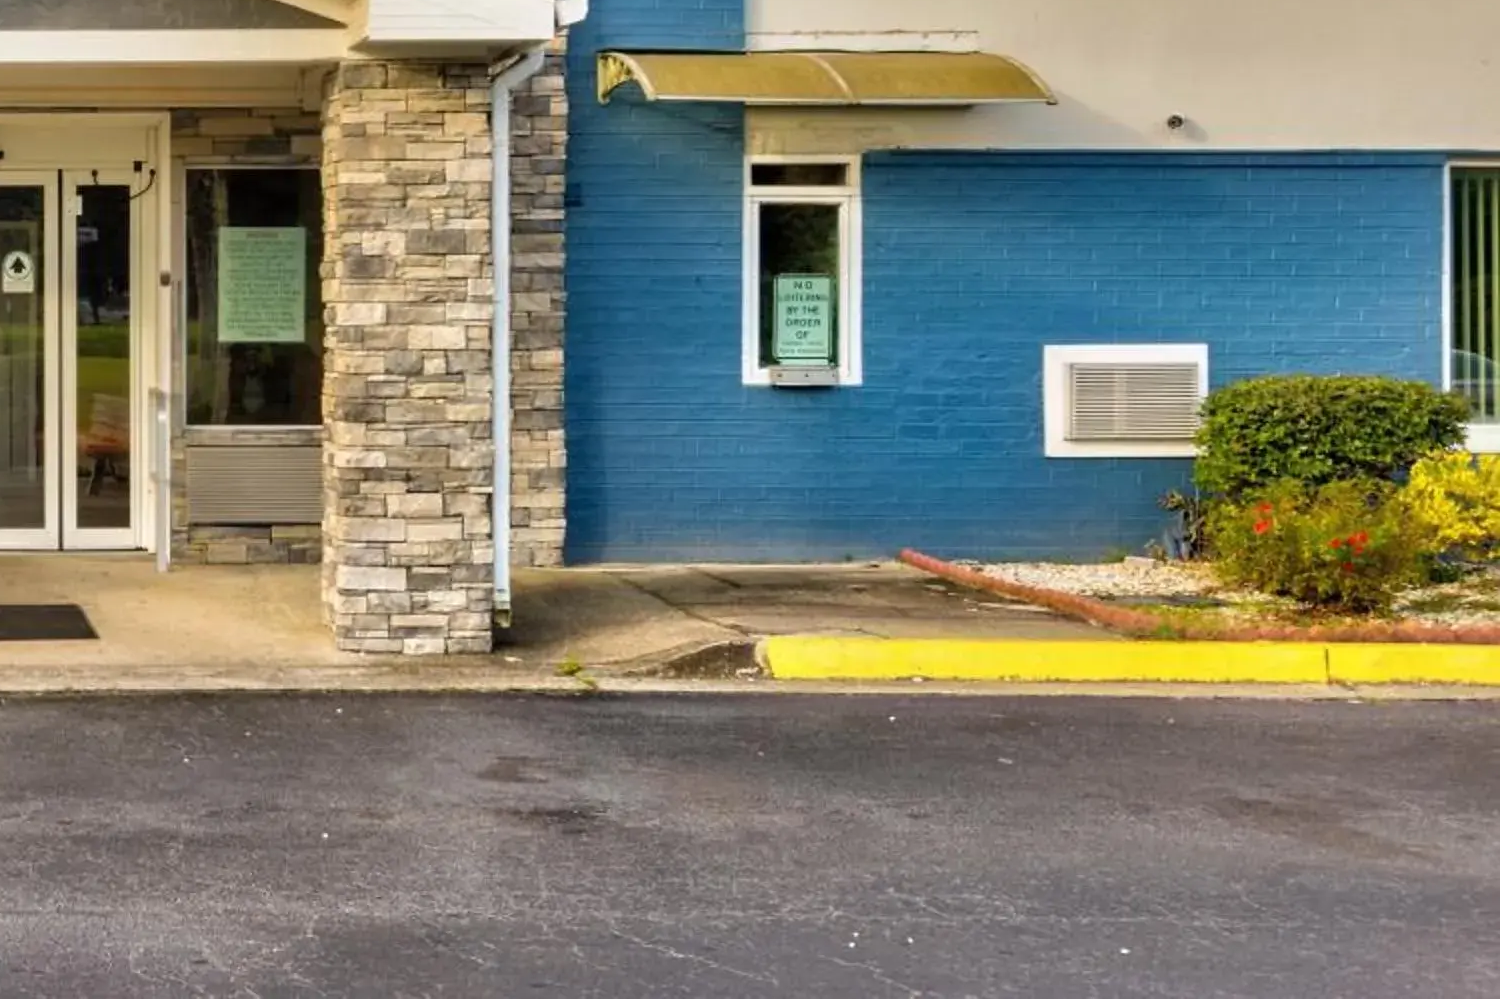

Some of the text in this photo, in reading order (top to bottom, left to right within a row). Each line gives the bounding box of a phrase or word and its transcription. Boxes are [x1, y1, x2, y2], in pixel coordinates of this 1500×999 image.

[793, 280, 813, 290] NO
[786, 305, 820, 315] BY THE
